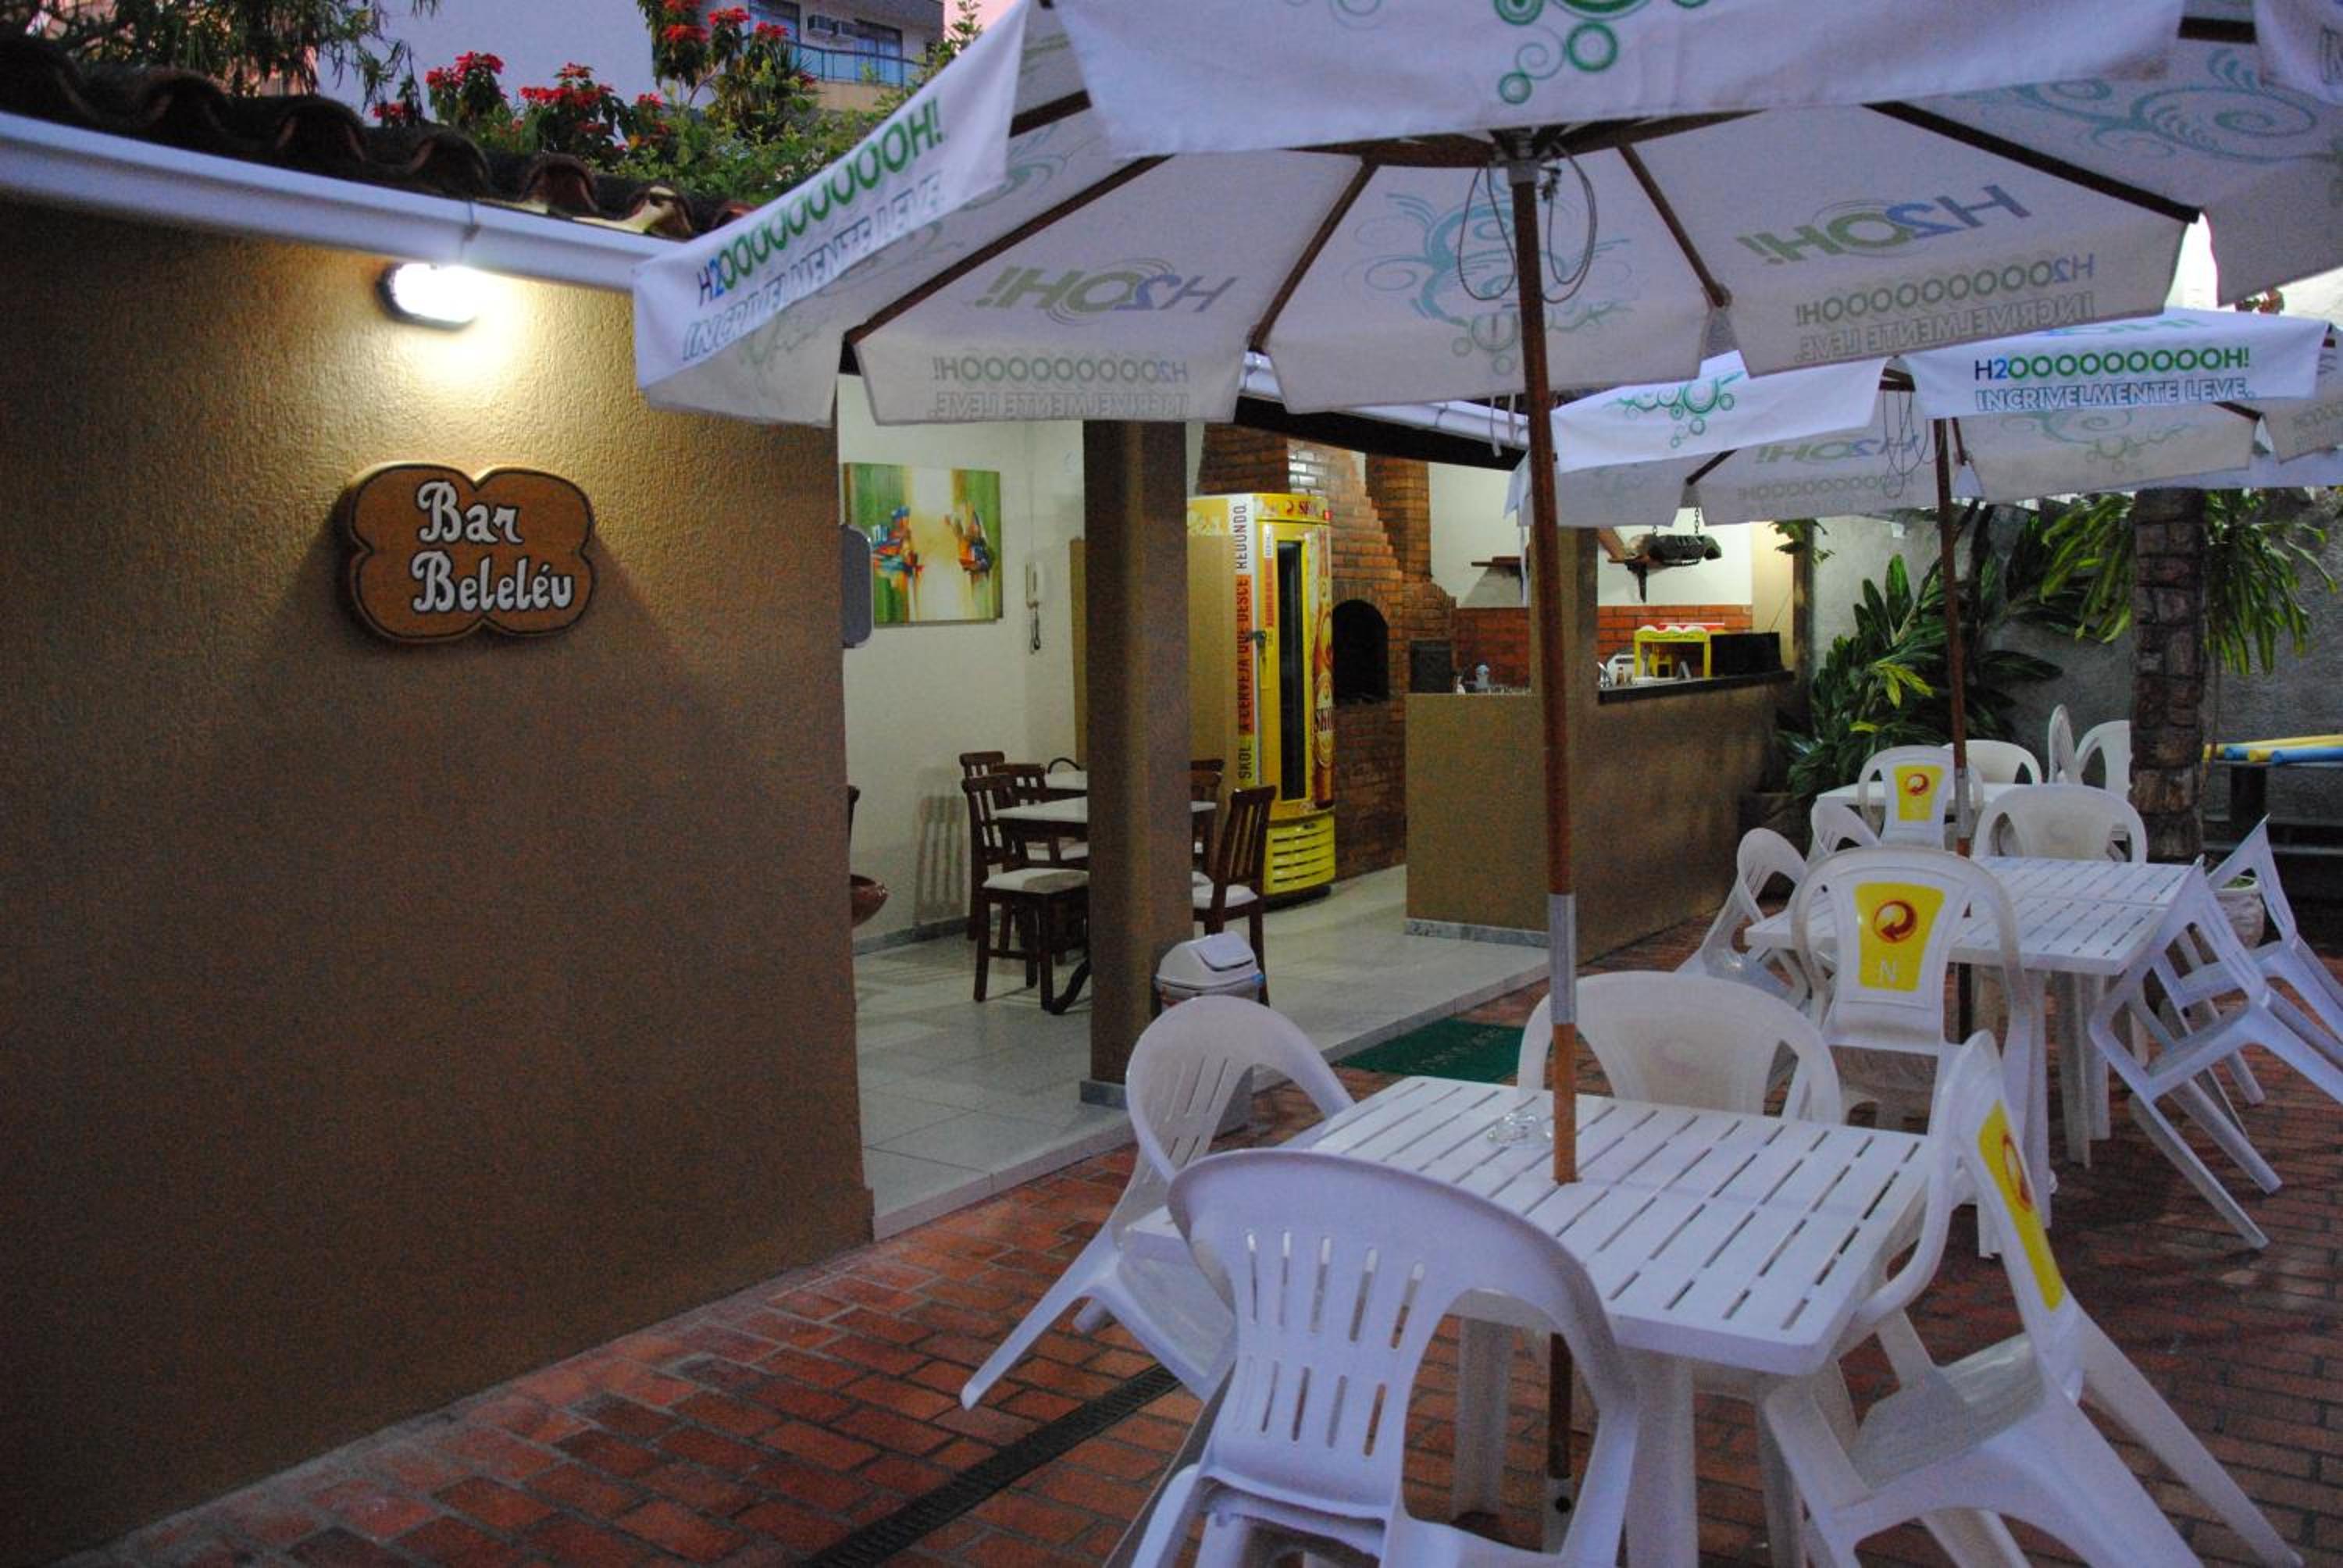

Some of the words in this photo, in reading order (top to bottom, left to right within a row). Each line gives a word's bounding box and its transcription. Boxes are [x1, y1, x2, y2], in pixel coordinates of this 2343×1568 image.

[1975, 380, 2177, 412] INCRIVELMENTE
[2185, 378, 2256, 401] LEVE.
[417, 480, 524, 544] Bar
[1236, 578, 1250, 622] DESCE
[1238, 743, 1252, 779] SKOL
